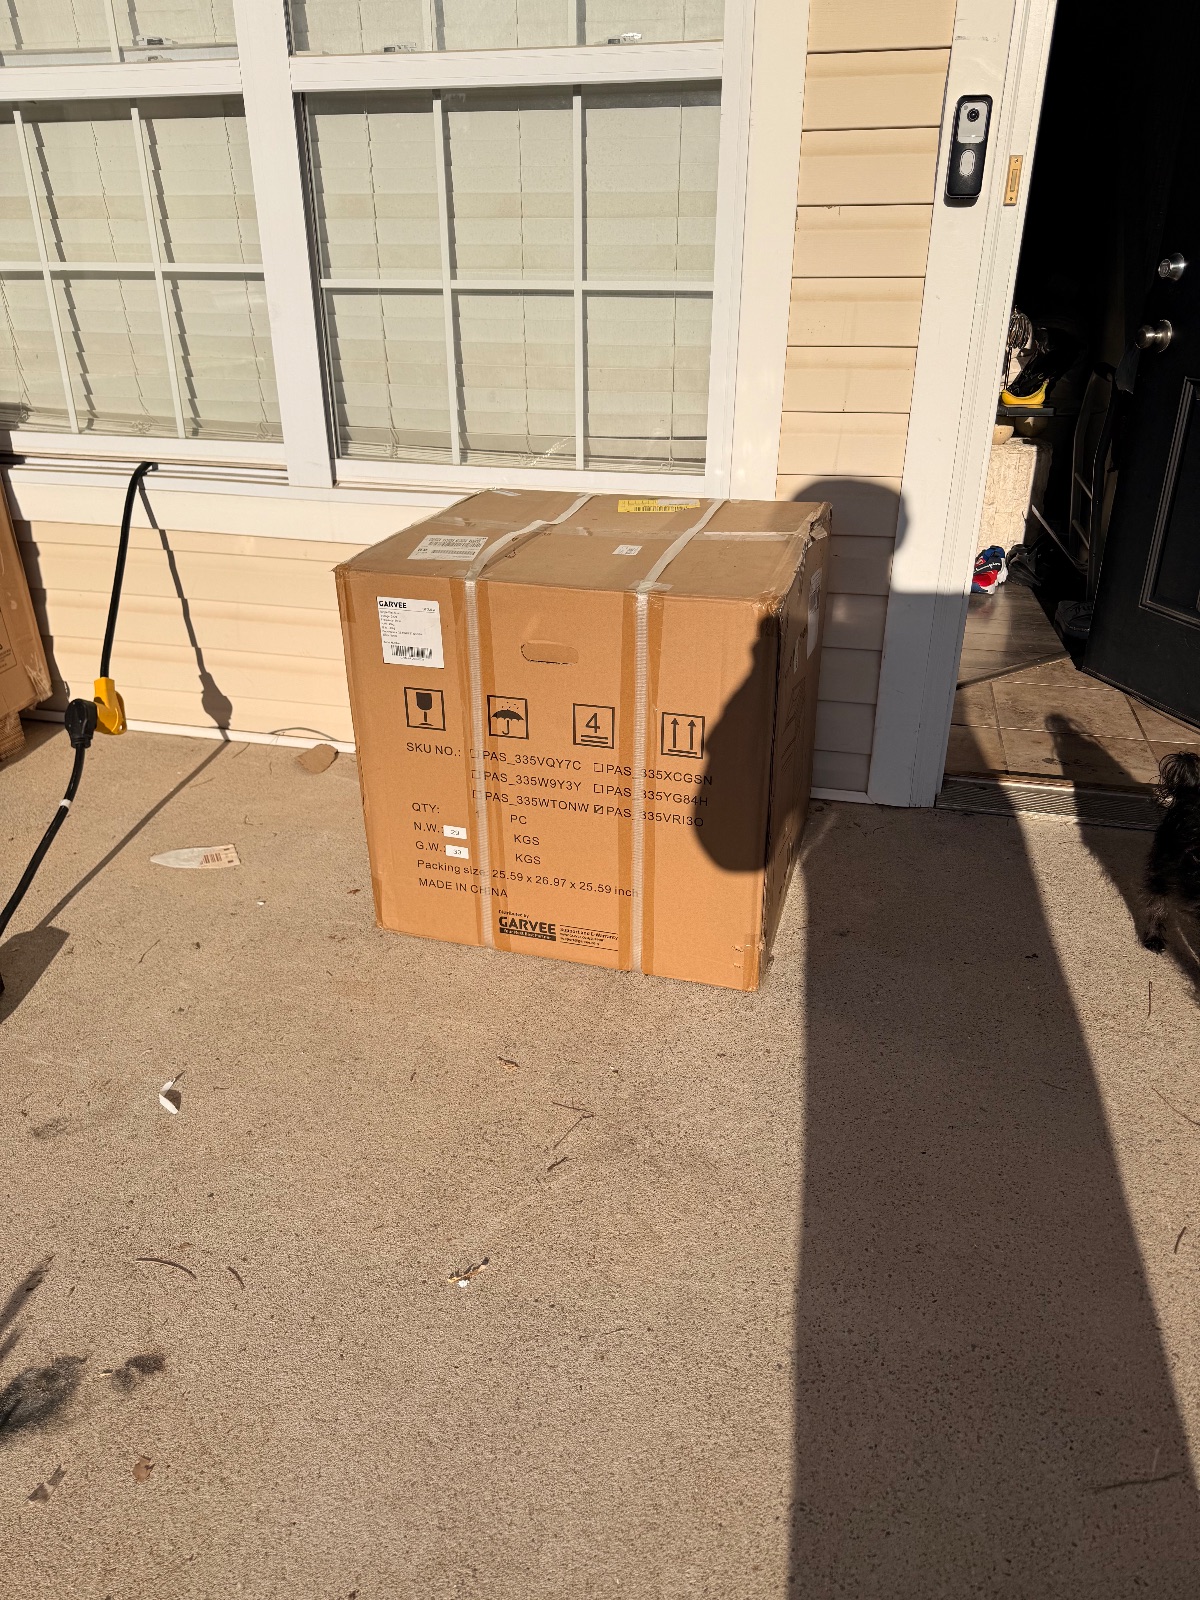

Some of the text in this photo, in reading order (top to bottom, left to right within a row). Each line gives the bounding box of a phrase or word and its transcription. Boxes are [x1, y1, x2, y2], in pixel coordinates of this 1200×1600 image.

[378, 600, 407, 609] GARVEE
[585, 712, 601, 734] 4
[406, 742, 432, 754] SKU
[435, 745, 461, 757] NO.:
[483, 750, 582, 771] PAS_335VQY7C
[484, 771, 582, 791] PAS_335W9Y3Y
[411, 802, 440, 814] QTY:
[510, 814, 528, 825] PC
[513, 834, 540, 846] KGS
[515, 853, 541, 865] KGS
[417, 859, 461, 875] Packing
[492, 869, 524, 882] 25.59
[526, 875, 533, 884] x
[535, 875, 567, 888] 26.97
[569, 881, 577, 890] x
[579, 881, 612, 894] 25.59
[418, 877, 453, 891] MADE
[455, 882, 468, 892] IN
[498, 916, 557, 935] GARVEE
